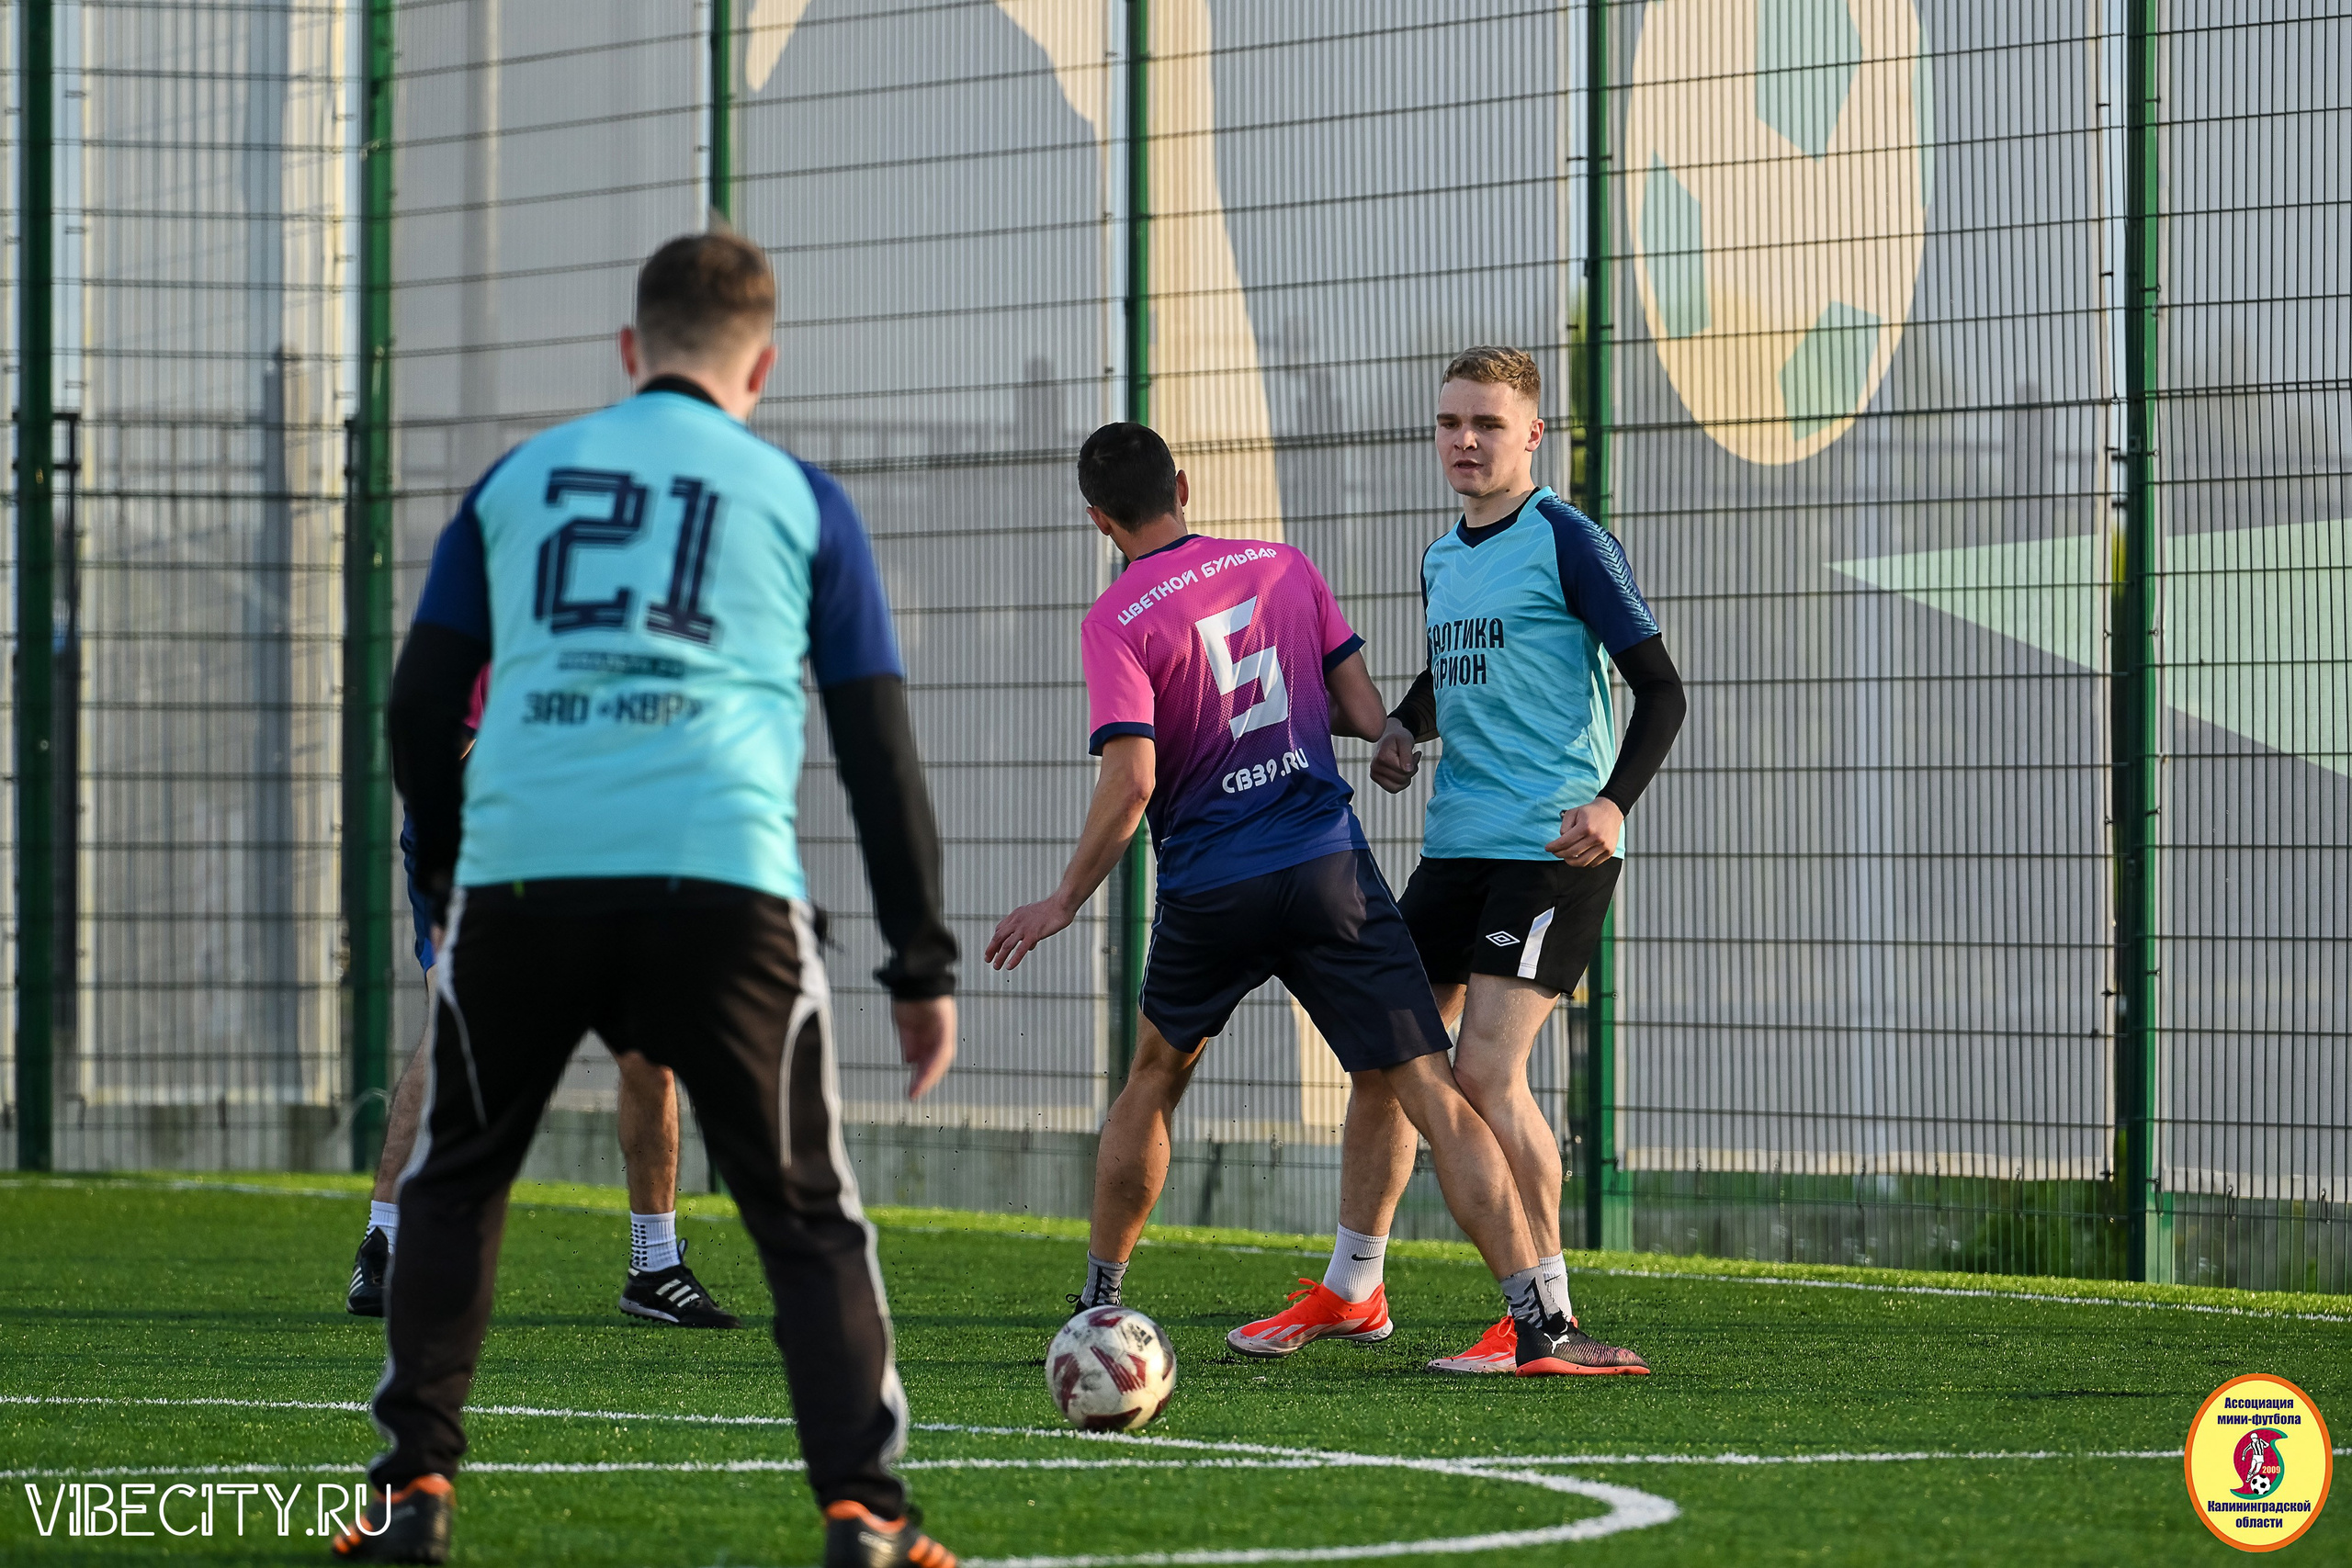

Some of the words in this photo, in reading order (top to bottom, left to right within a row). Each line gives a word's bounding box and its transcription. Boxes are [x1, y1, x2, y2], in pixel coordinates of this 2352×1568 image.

[534, 467, 723, 646] 21
[1117, 569, 1198, 626] ЦВЕТНОЙ
[1201, 547, 1277, 578] БУЛЬВАР
[1195, 595, 1288, 741] 5
[1433, 653, 1487, 690] ОРИОН
